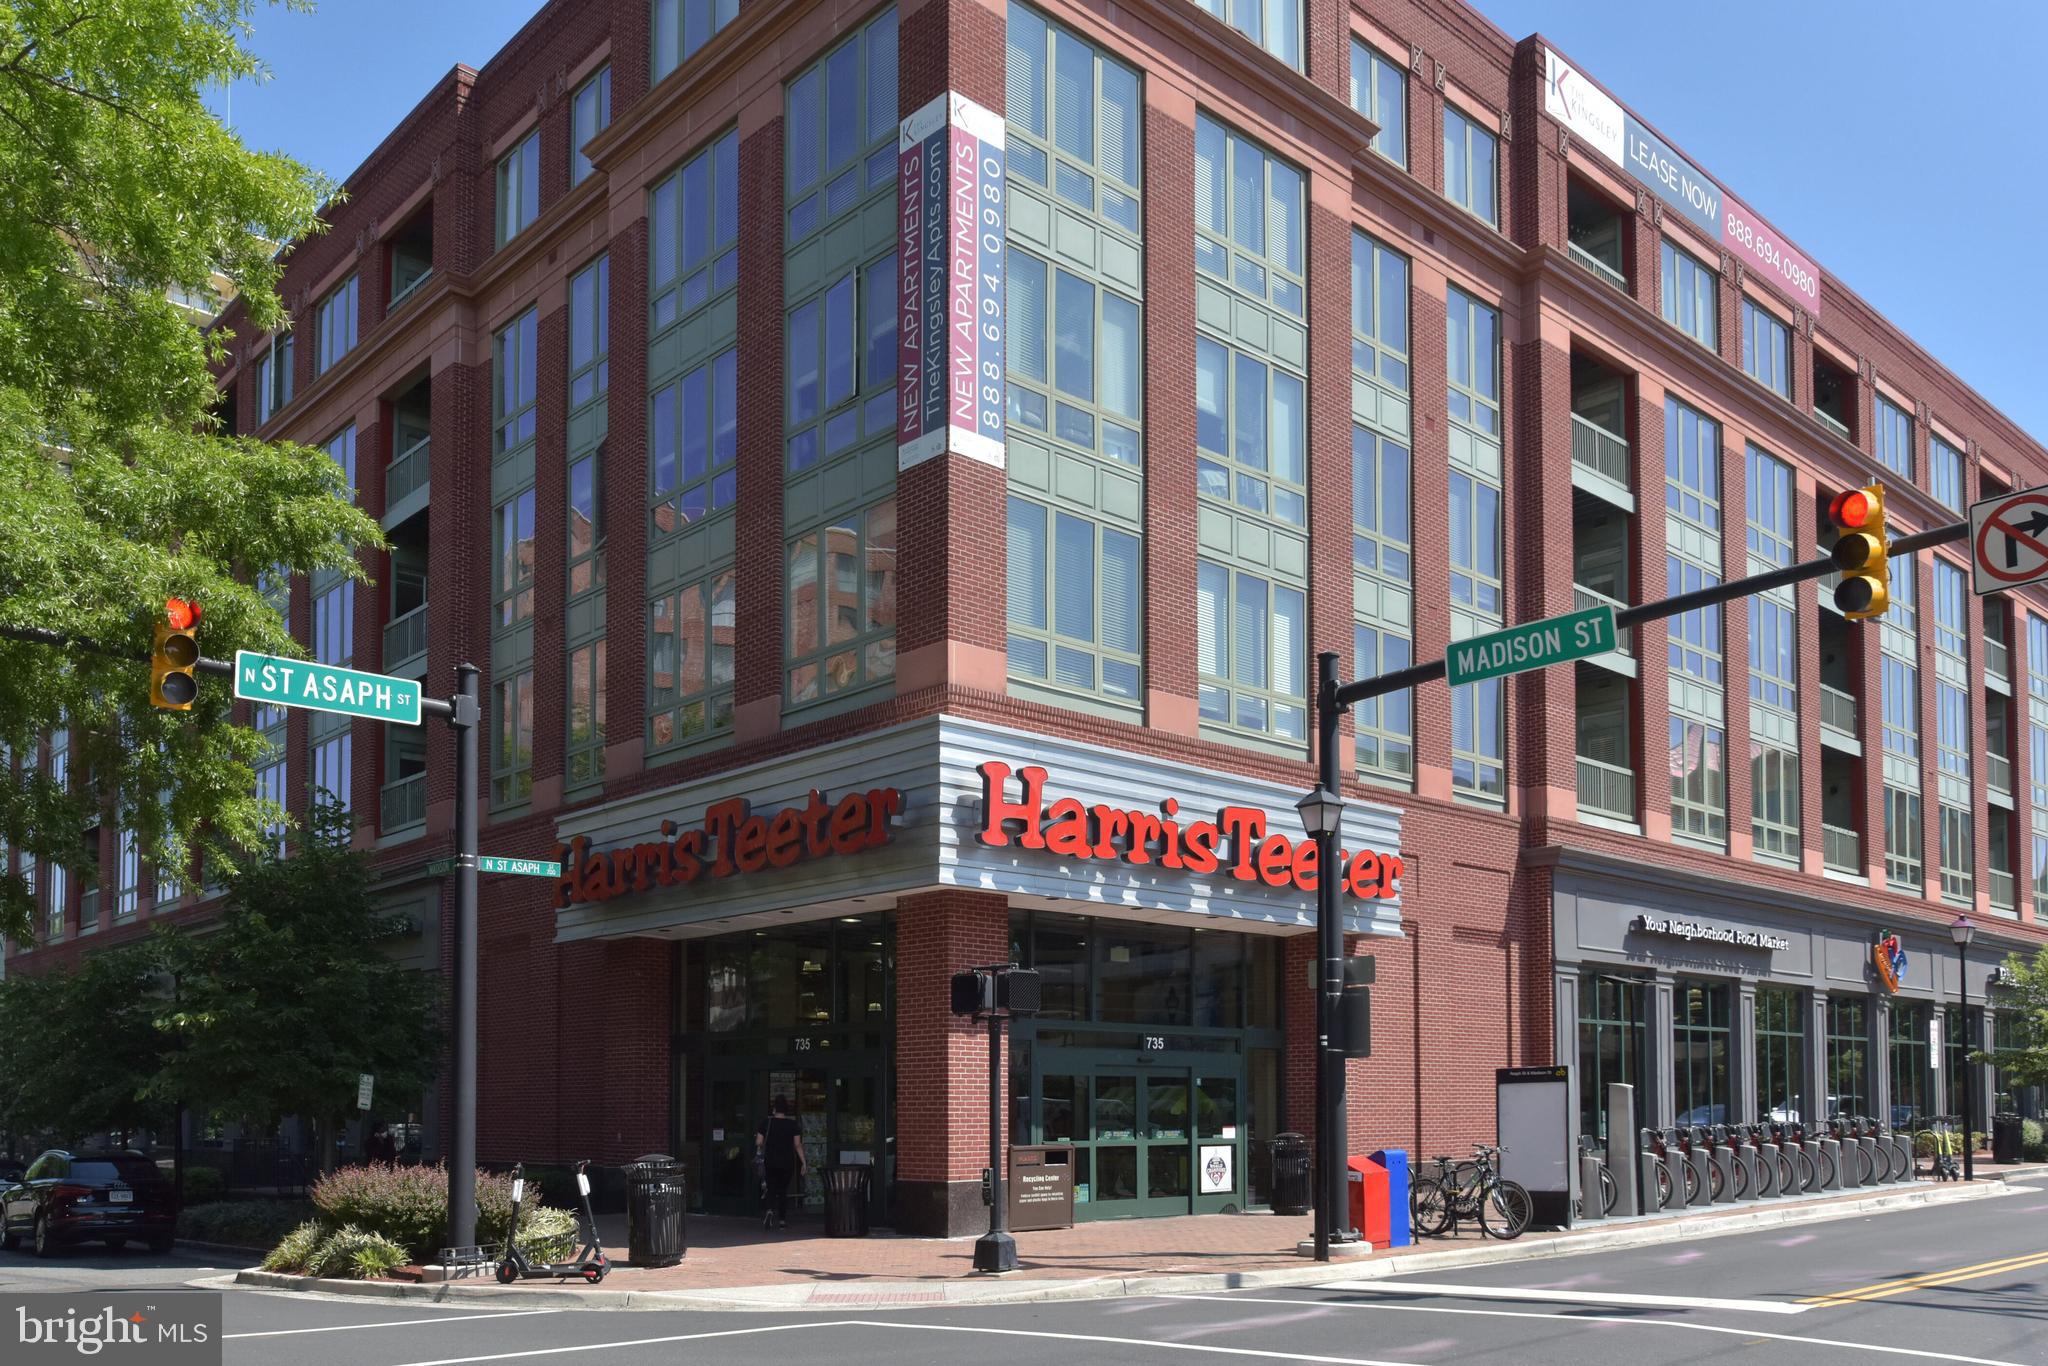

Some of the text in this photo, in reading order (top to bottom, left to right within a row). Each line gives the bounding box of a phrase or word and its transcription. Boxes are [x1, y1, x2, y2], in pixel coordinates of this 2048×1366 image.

[1571, 98, 1617, 142] KINGSLEY
[1630, 133, 1717, 220] LEASE NOW
[904, 155, 919, 350] APARTMENTS
[926, 141, 944, 422] TheKingsleyApts.com
[955, 142, 974, 420] NEW APARTMENTS
[1727, 212, 1815, 298] 888.694.0980
[983, 157, 1001, 429] 888.694.0980
[903, 364, 919, 433] NEW
[1458, 616, 1603, 676] MADISON ST
[245, 664, 411, 711] N ST ASAPH ST
[486, 859, 540, 874] N ST ASAPH
[1643, 914, 1790, 950] Your Neighborhood Food Market
[795, 1038, 811, 1051] 735
[1146, 1037, 1164, 1050] 735
[1022, 1175, 1044, 1183] Recycling
